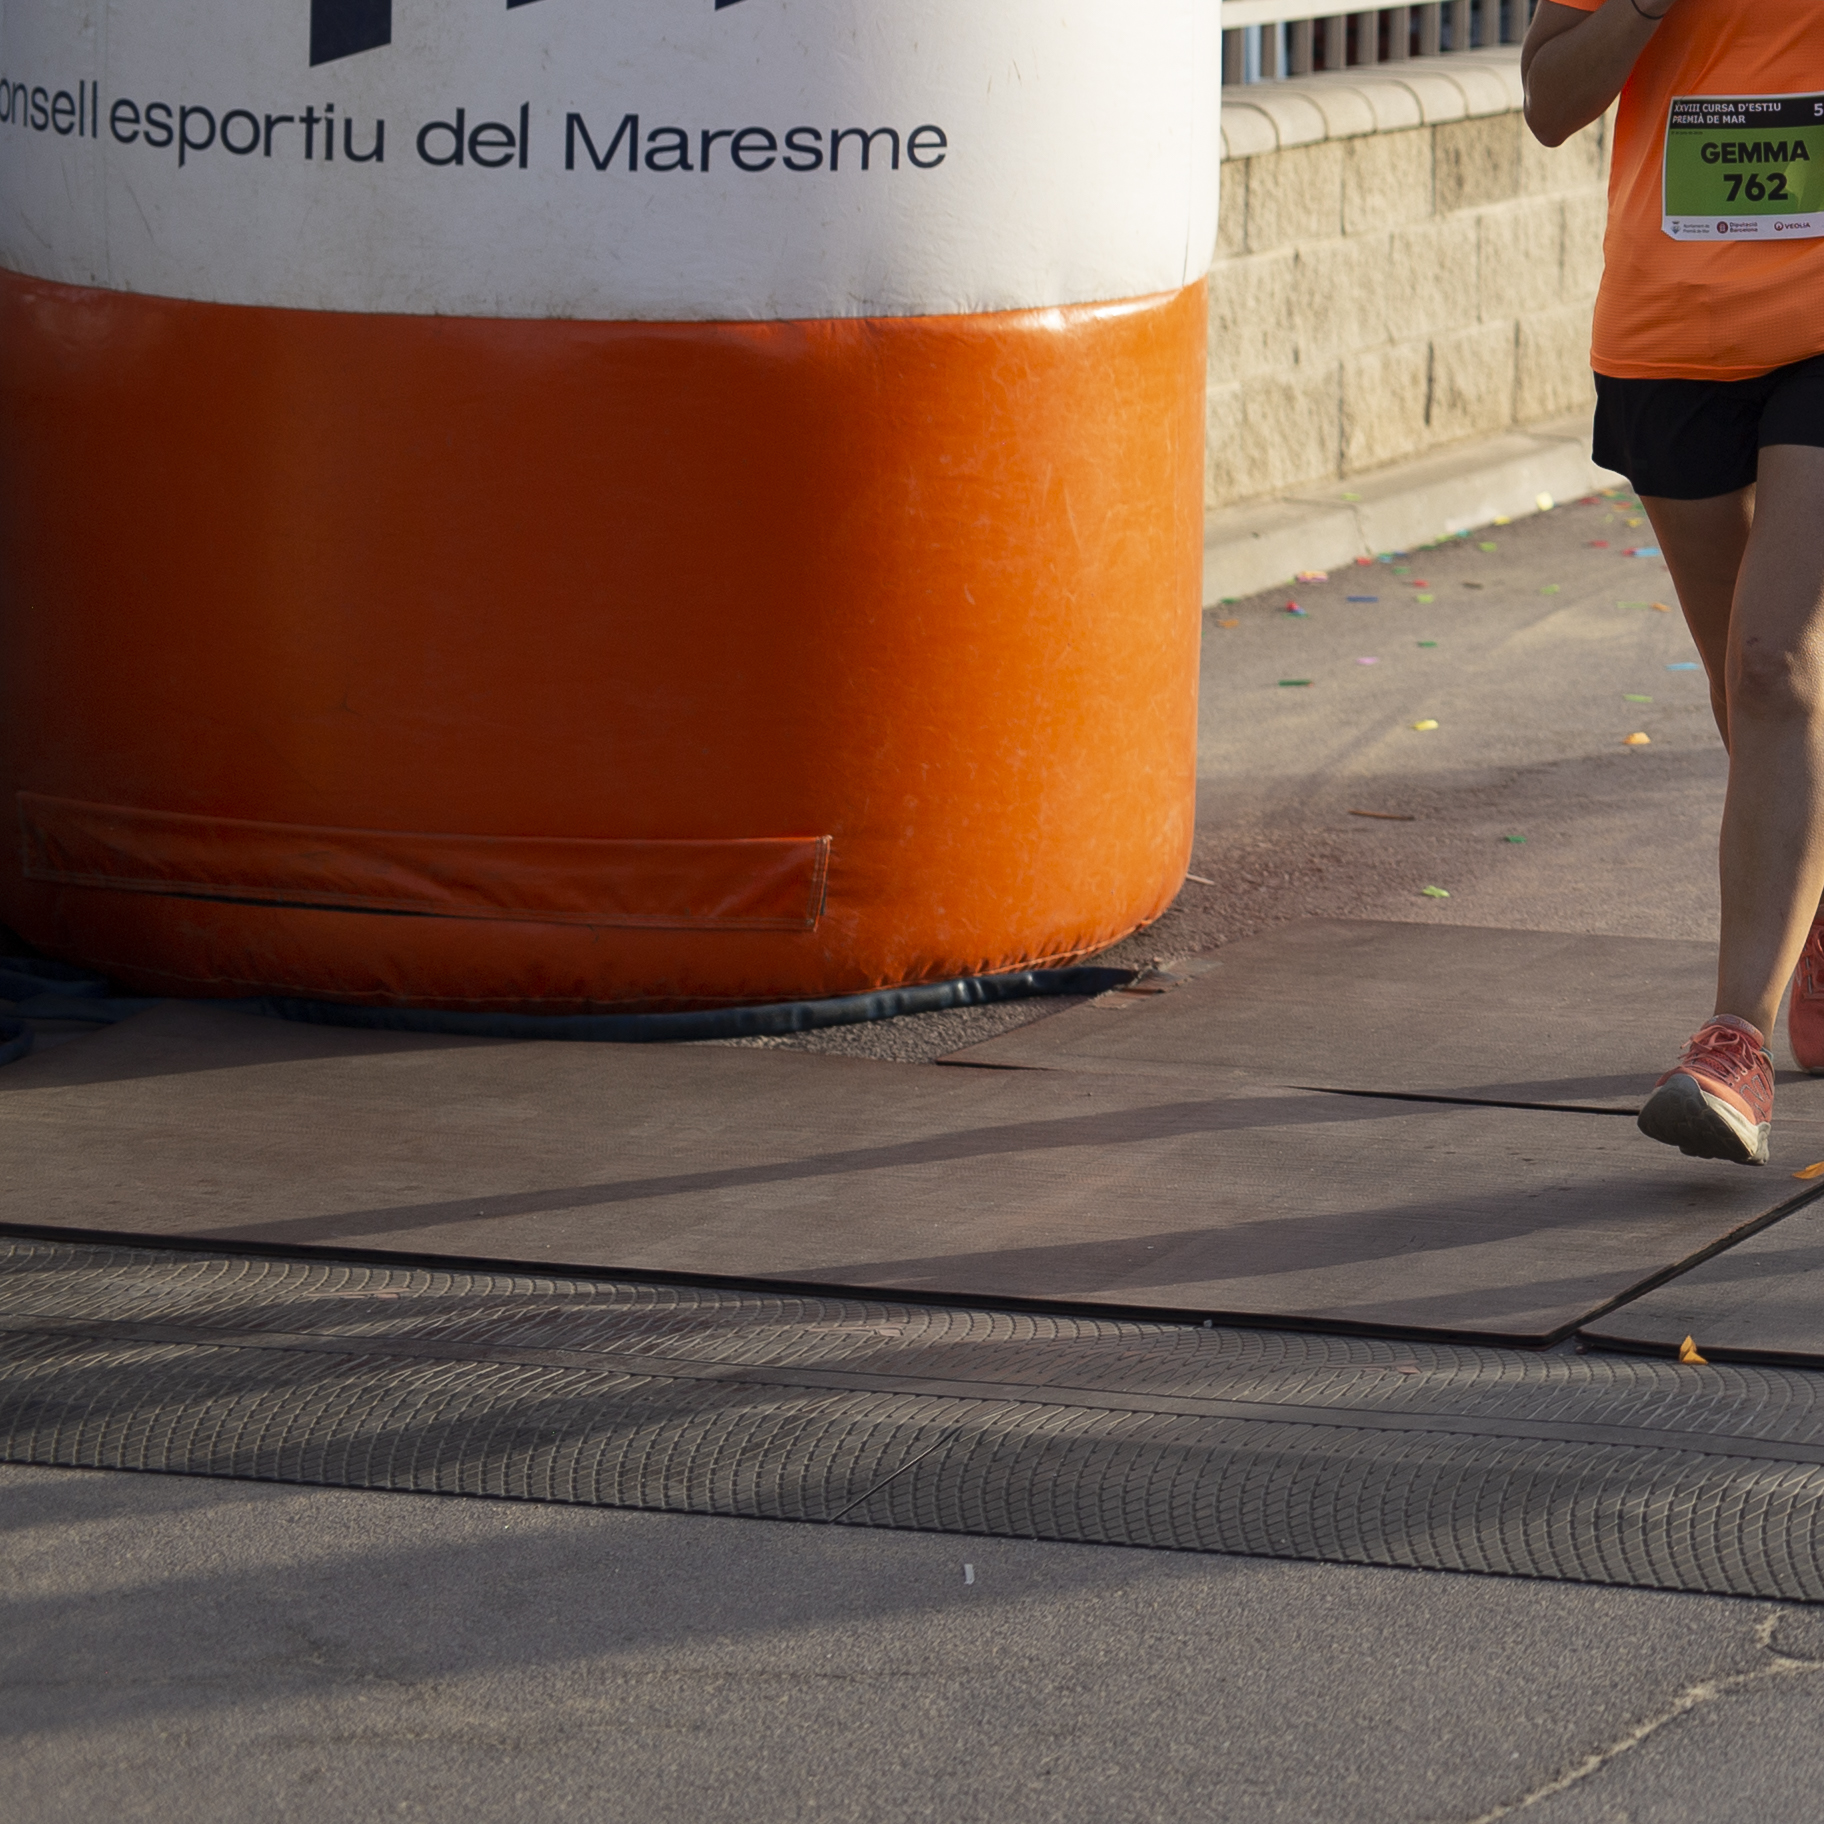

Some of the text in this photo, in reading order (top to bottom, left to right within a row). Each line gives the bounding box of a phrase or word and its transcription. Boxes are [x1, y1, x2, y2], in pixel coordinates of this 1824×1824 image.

[1672, 113, 1746, 124] PREMIÀ DE MAR
[1674, 102, 1782, 112] XXVIII CURSA D'ESTIU
[0, 78, 948, 172] onsell esportiu del Maresme
[1700, 140, 1811, 164] GEMMA
[1723, 172, 1789, 202] 762
